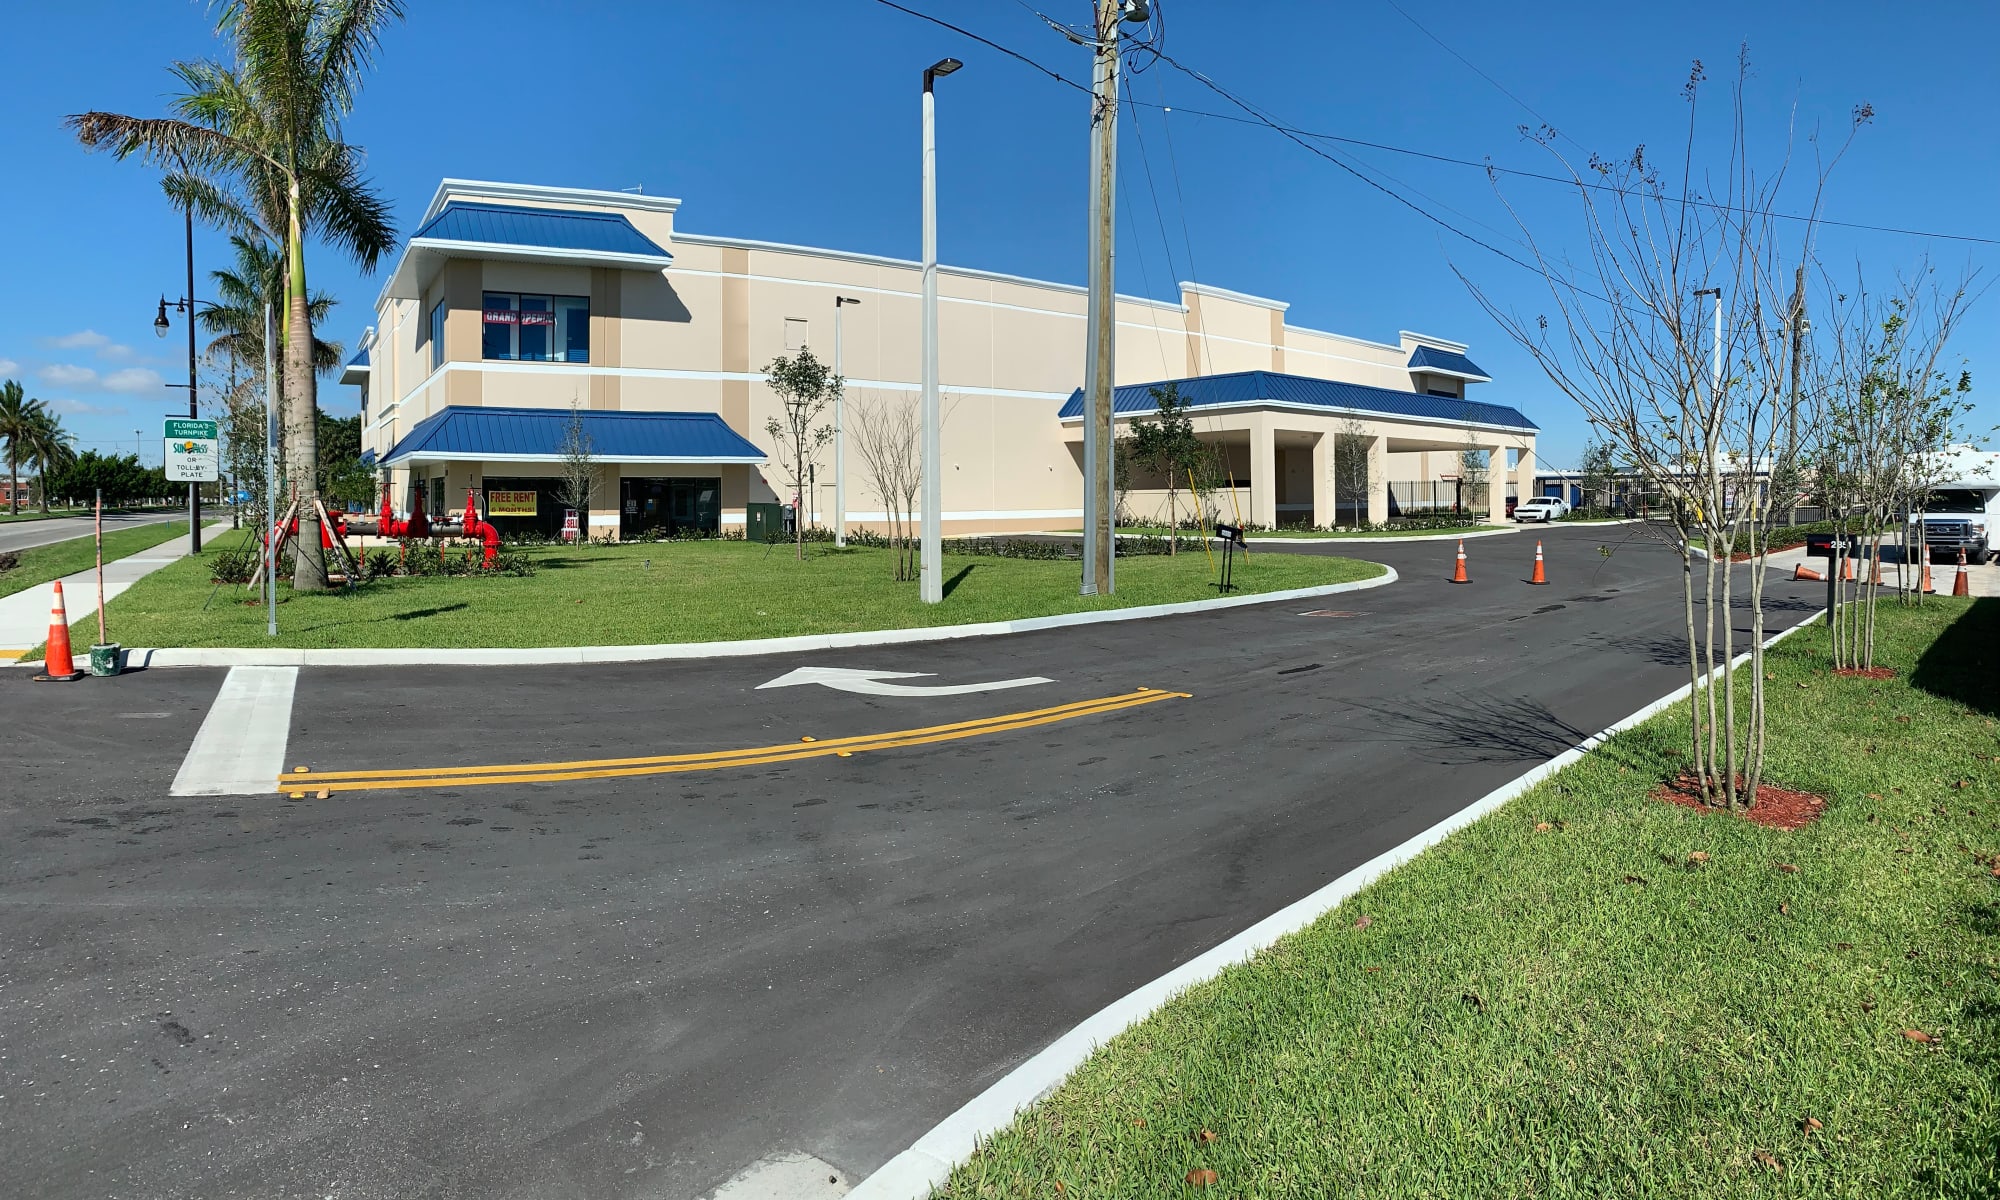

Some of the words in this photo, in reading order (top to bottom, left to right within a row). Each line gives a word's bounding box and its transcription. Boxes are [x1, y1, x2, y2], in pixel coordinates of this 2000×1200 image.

[486, 311, 517, 322] GRAND
[490, 492, 511, 502] FREE
[513, 492, 535, 502] RENT
